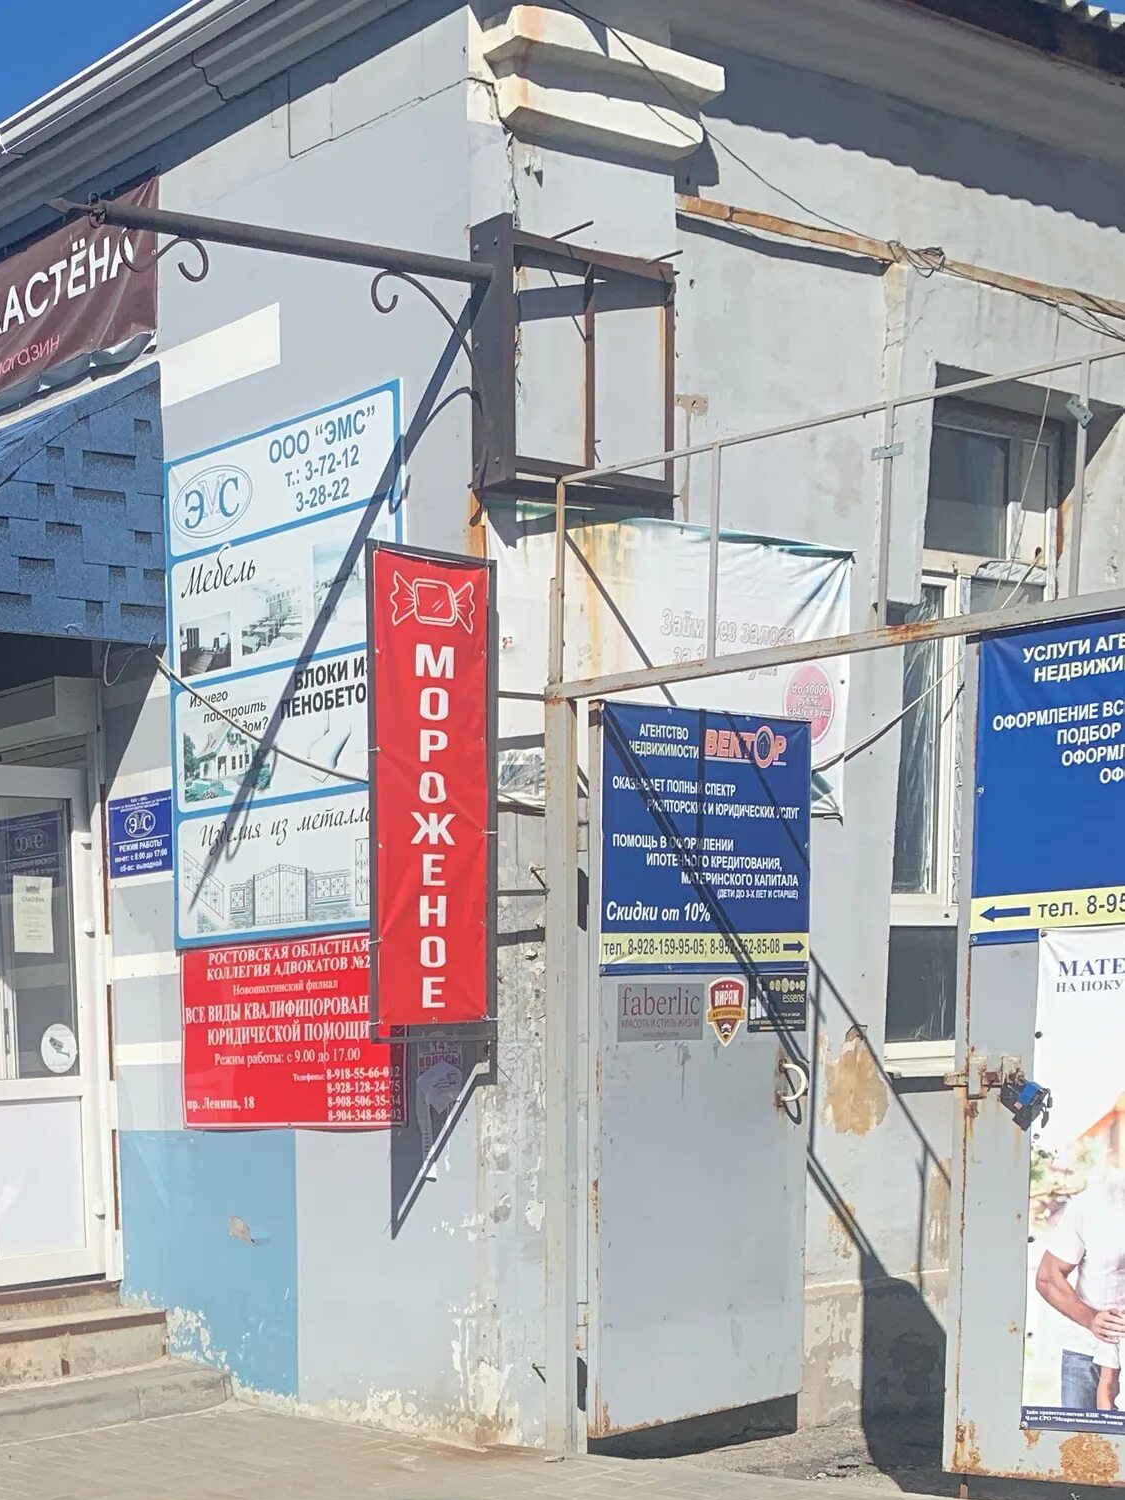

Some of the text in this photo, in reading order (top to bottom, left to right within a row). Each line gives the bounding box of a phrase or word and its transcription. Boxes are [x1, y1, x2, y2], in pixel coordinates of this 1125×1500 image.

[269, 430, 310, 464] ООО
[285, 444, 359, 488] т.: 3-72-12
[295, 477, 350, 512] 3-28-22
[181, 546, 256, 598] Мебель
[660, 608, 705, 638] Займ
[1023, 638, 1090, 663] УСЛУГИ
[293, 657, 367, 692] БЛОКИ И
[1034, 655, 1125, 683] НЕДВИЖИ
[190, 691, 228, 709] Из чего
[203, 702, 267, 724] построить
[993, 699, 1125, 731] ОФОРМЛЕНИЕ ВС
[241, 717, 269, 734] дом?
[639, 723, 689, 741] АГЕНТСТВО
[1057, 722, 1121, 745] ПОДБОР
[629, 740, 700, 760] НЕДВИЖИМОСТИ
[704, 725, 787, 769] ВЕКТОР
[1100, 767, 1125, 784] ОФ
[612, 776, 736, 797] ОКАЗЫВАЕТ ПОЛНЫЙ СПЕКТР
[708, 805, 714, 816] И
[715, 804, 775, 819] ЮРИДИЧЕСКИХ
[776, 806, 800, 820] УСЛУГ
[200, 822, 261, 856] Изделия
[271, 818, 288, 845] из
[410, 644, 457, 1010] МОРОЖЕНОЕ
[139, 839, 163, 850] РАБОТЫ
[154, 848, 167, 857] 17:00
[612, 833, 734, 852] ПОМОЩЬ В ОФОРМЛЕНИИ
[646, 853, 783, 871] ИПОТЕЧНОГО КРЕДИТОВАНИЯ,
[681, 872, 799, 887] МАТЕРИНСКОГО КАПИТАЛА
[736, 890, 745, 899] ДО
[606, 901, 711, 922] Скидки от 10%
[1038, 902, 1079, 918] тел.
[208, 938, 370, 966] РОСТОВСКАЯ ОБЛАСТНАЯ
[604, 941, 625, 956] тел.
[628, 938, 707, 958] 8-928-159-95-05;
[206, 963, 271, 981] КОЛЛЕГИЯ
[273, 956, 348, 976] АДВОКАТОВ
[1059, 957, 1125, 977] МАТЕ
[233, 979, 338, 996] Новошахтинский филиал
[1056, 979, 1124, 993] НА ПОКУ
[622, 987, 700, 1016] faberlic
[715, 989, 740, 1006] ВИРАЖ
[783, 993, 805, 1003] essens
[185, 1006, 206, 1024] ВСЕ
[208, 1002, 241, 1023] ВИДЫ
[207, 1020, 370, 1046] ЮРИДИЧЕСКОЙ ПОМОЩИ
[215, 1048, 361, 1067] Режим работы: с 9.00 до 17.00
[327, 1081, 400, 1094] 8-928-128-24-75
[202, 1097, 241, 1111] Ленина,
[244, 1096, 255, 1109] 18
[327, 1094, 401, 1107] 8-908-506-35-34
[328, 1108, 401, 1121] 8-904-348-68-02
